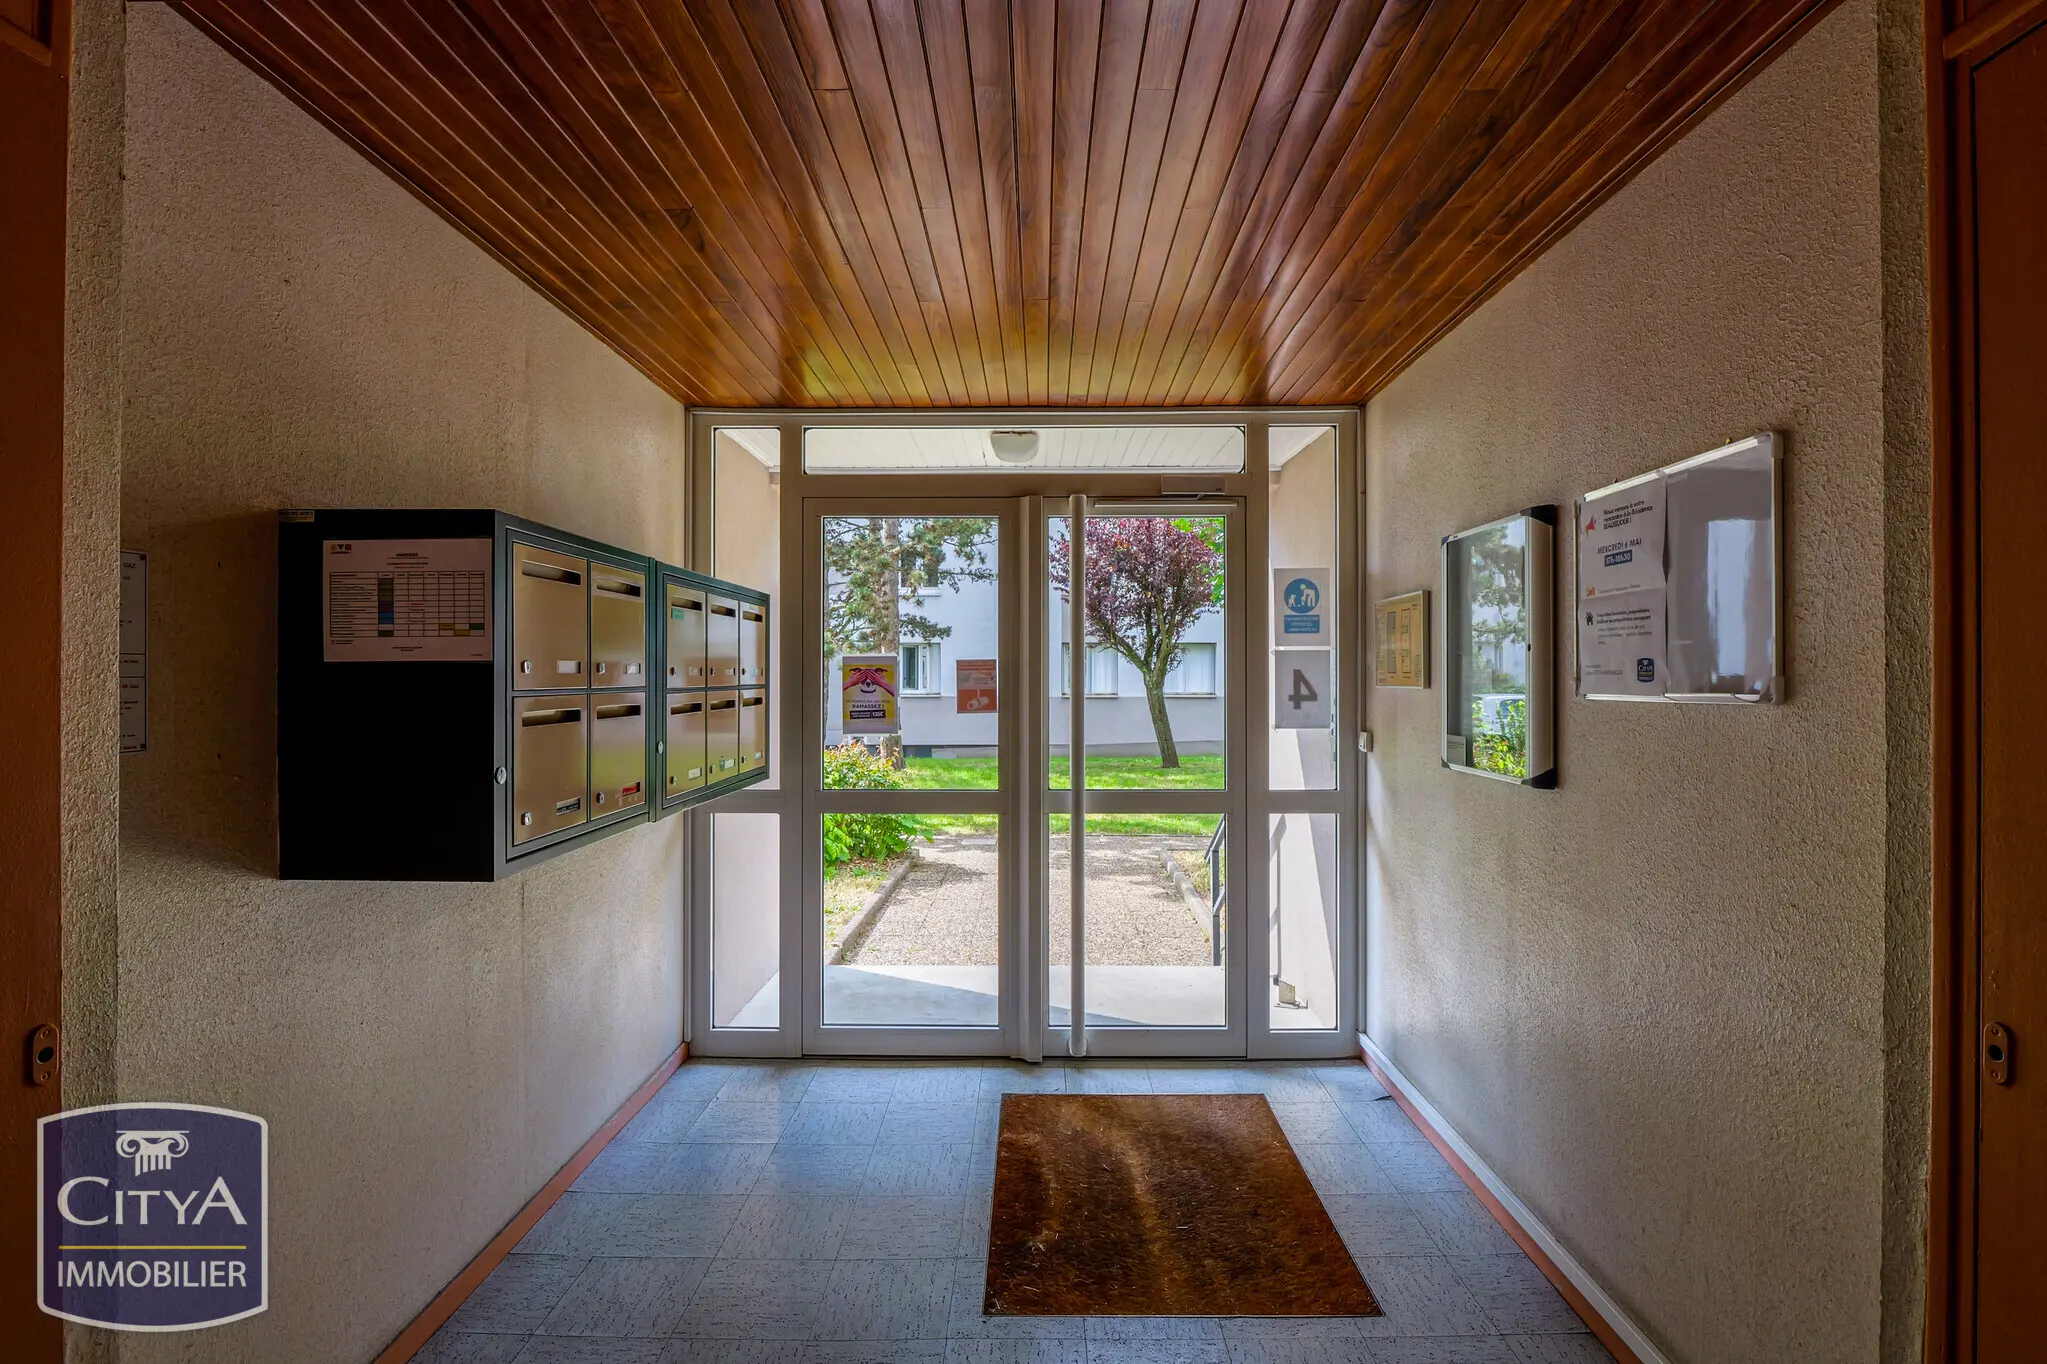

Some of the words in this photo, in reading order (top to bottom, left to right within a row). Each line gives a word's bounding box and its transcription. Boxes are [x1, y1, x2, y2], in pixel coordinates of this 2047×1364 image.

[1603, 508, 1614, 516] Nous
[1597, 541, 1624, 555] MERCREDI
[1629, 537, 1642, 547] MAI
[123, 561, 136, 569] GAZ
